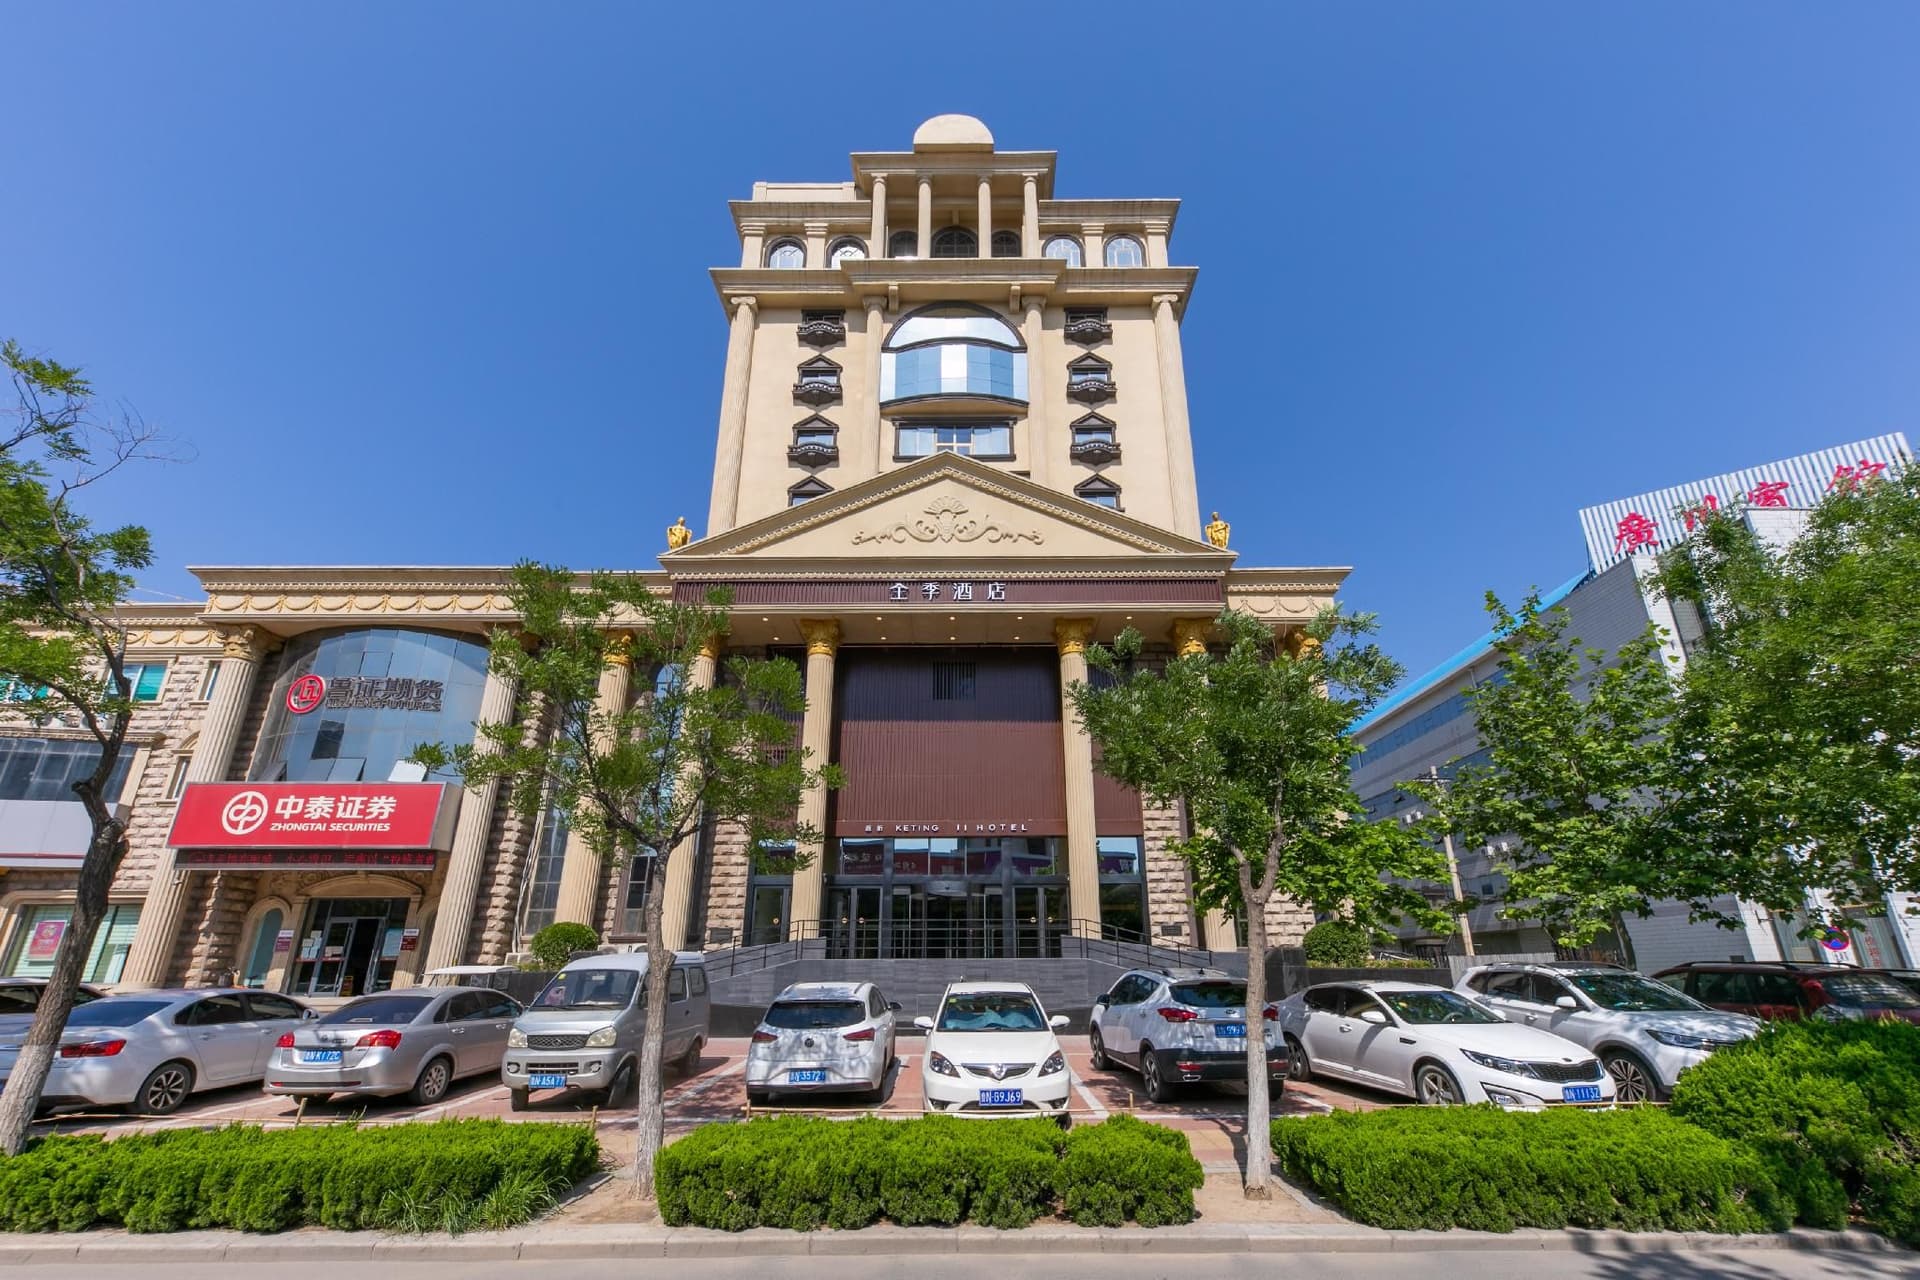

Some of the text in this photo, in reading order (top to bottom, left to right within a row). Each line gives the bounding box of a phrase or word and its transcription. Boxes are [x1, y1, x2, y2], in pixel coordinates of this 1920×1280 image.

[889, 582, 1006, 600] 全季酒店
[274, 795, 397, 820] 中泰证券
[269, 822, 391, 832] ZHONGTAI SECURITIES
[976, 823, 1028, 832] HOTEL
